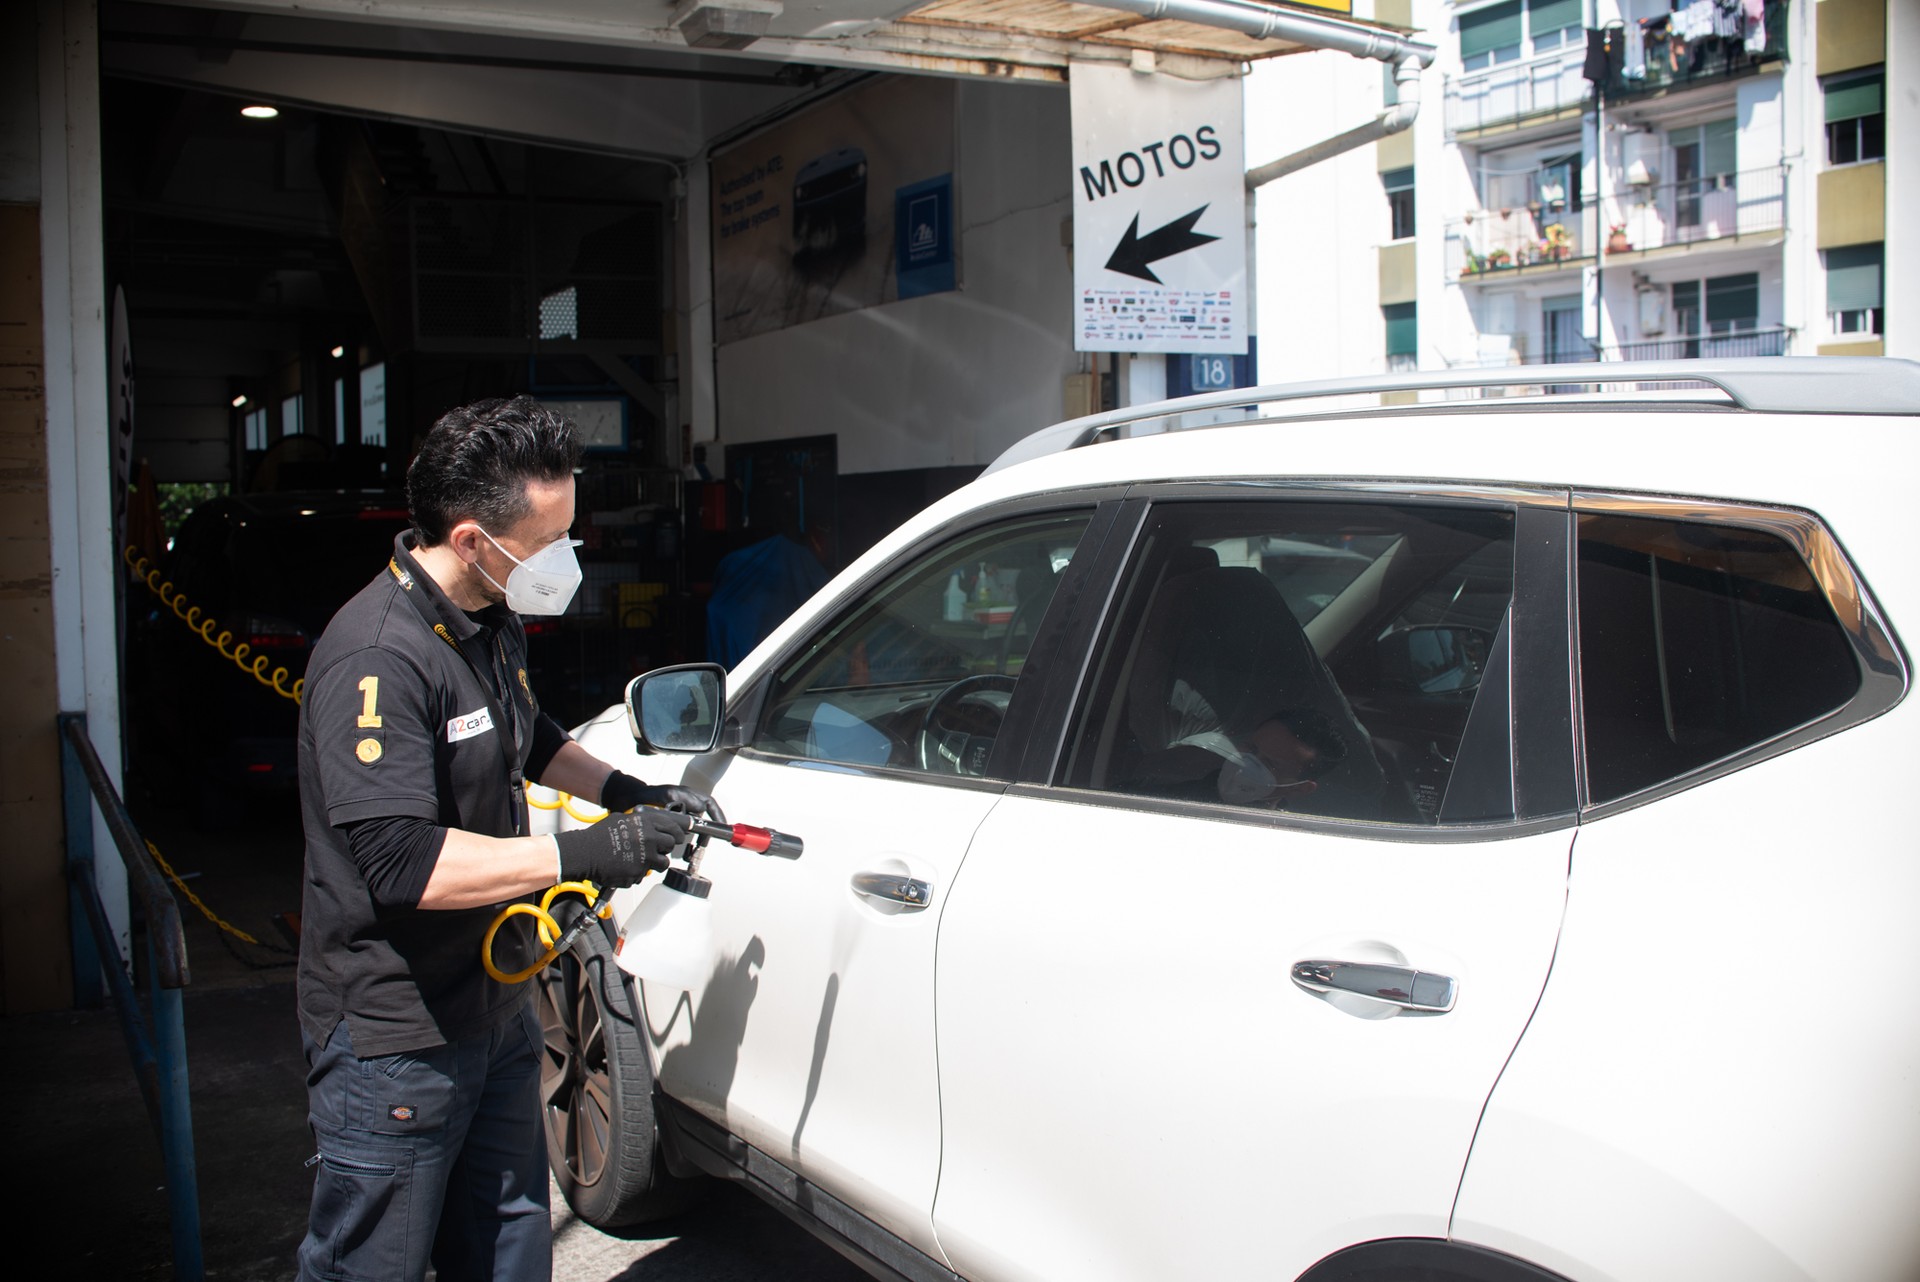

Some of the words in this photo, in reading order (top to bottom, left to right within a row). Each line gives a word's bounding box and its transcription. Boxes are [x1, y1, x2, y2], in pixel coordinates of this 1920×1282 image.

[1080, 125, 1221, 202] MOTOS
[1200, 356, 1226, 386] 18
[357, 676, 382, 728] 1
